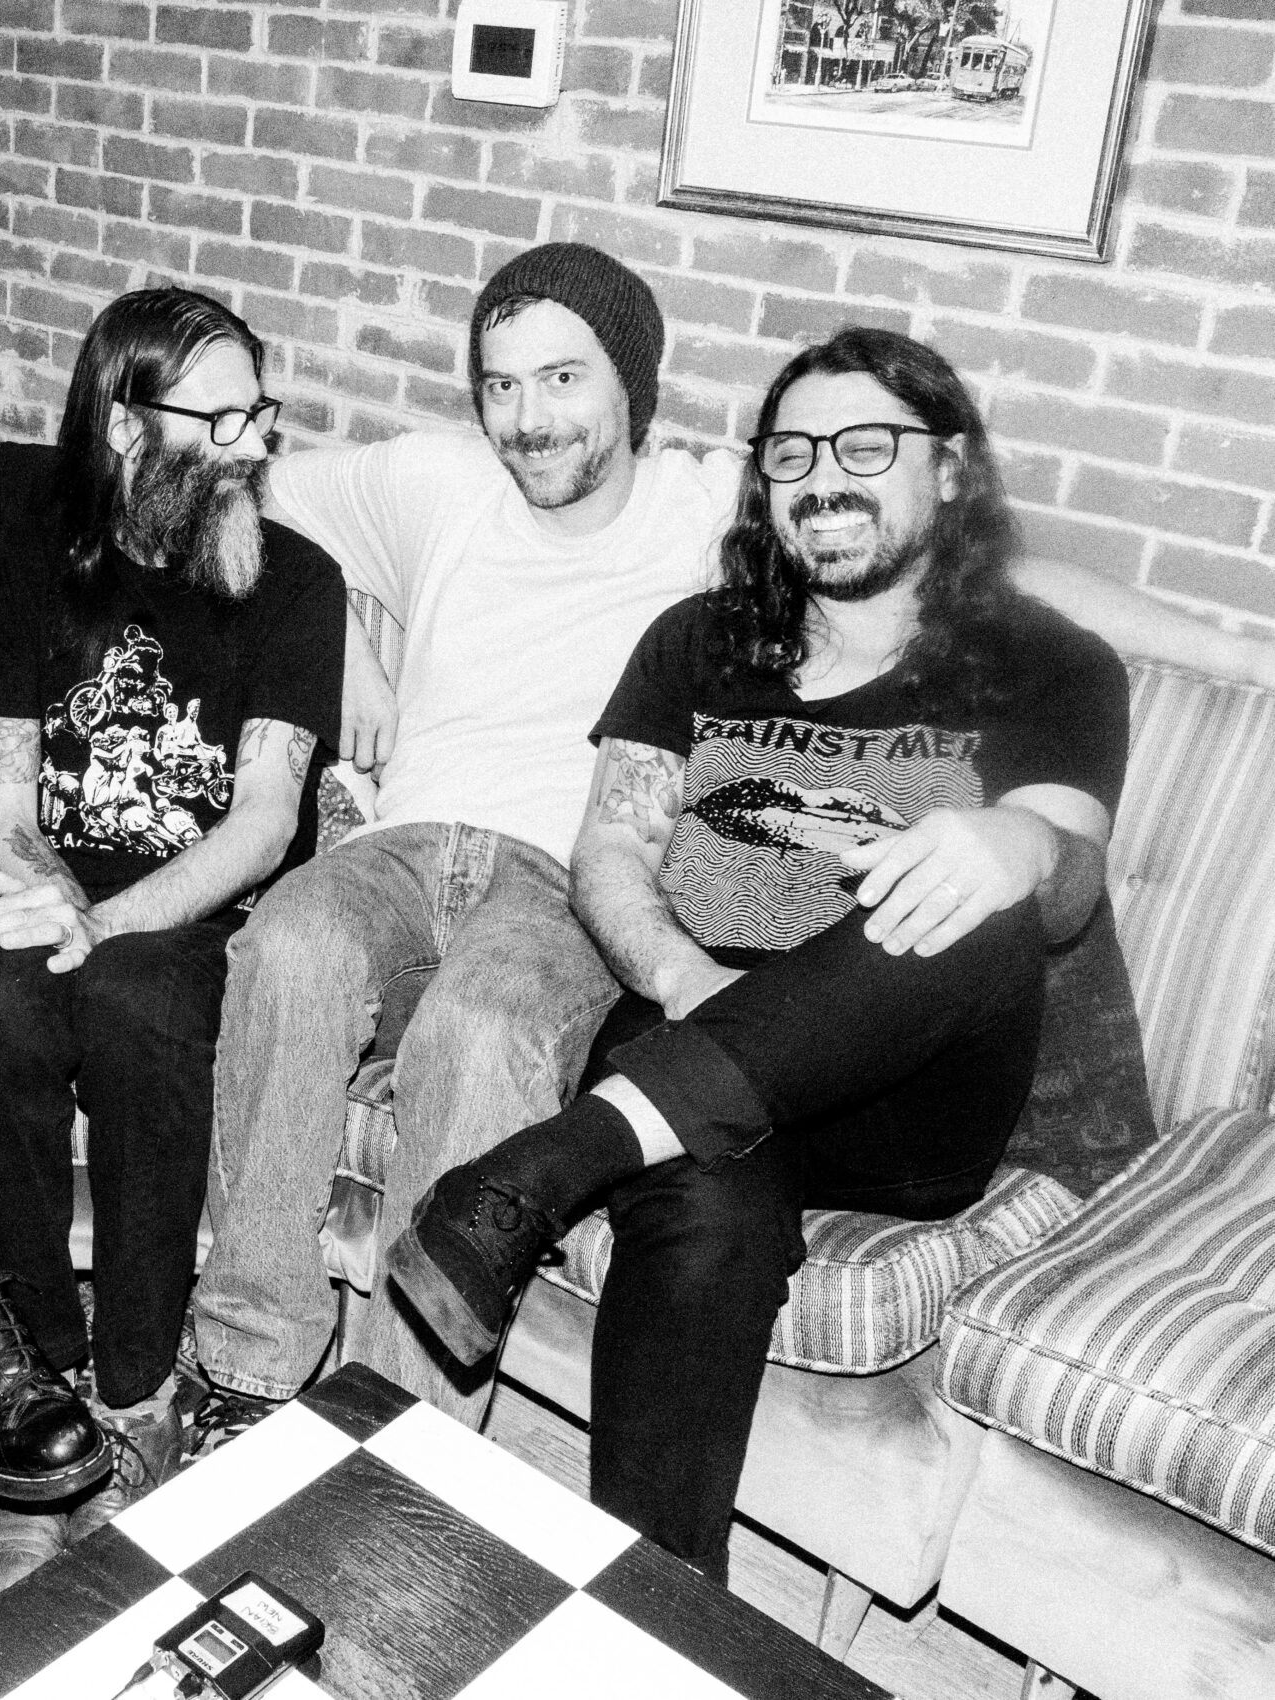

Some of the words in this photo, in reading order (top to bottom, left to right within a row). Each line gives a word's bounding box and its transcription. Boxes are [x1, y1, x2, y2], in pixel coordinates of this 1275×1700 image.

[697, 719, 879, 761] GAINST
[241, 1606, 279, 1635] BRIAN
[257, 1601, 282, 1622] NEW
[188, 1649, 214, 1671] SHURE
